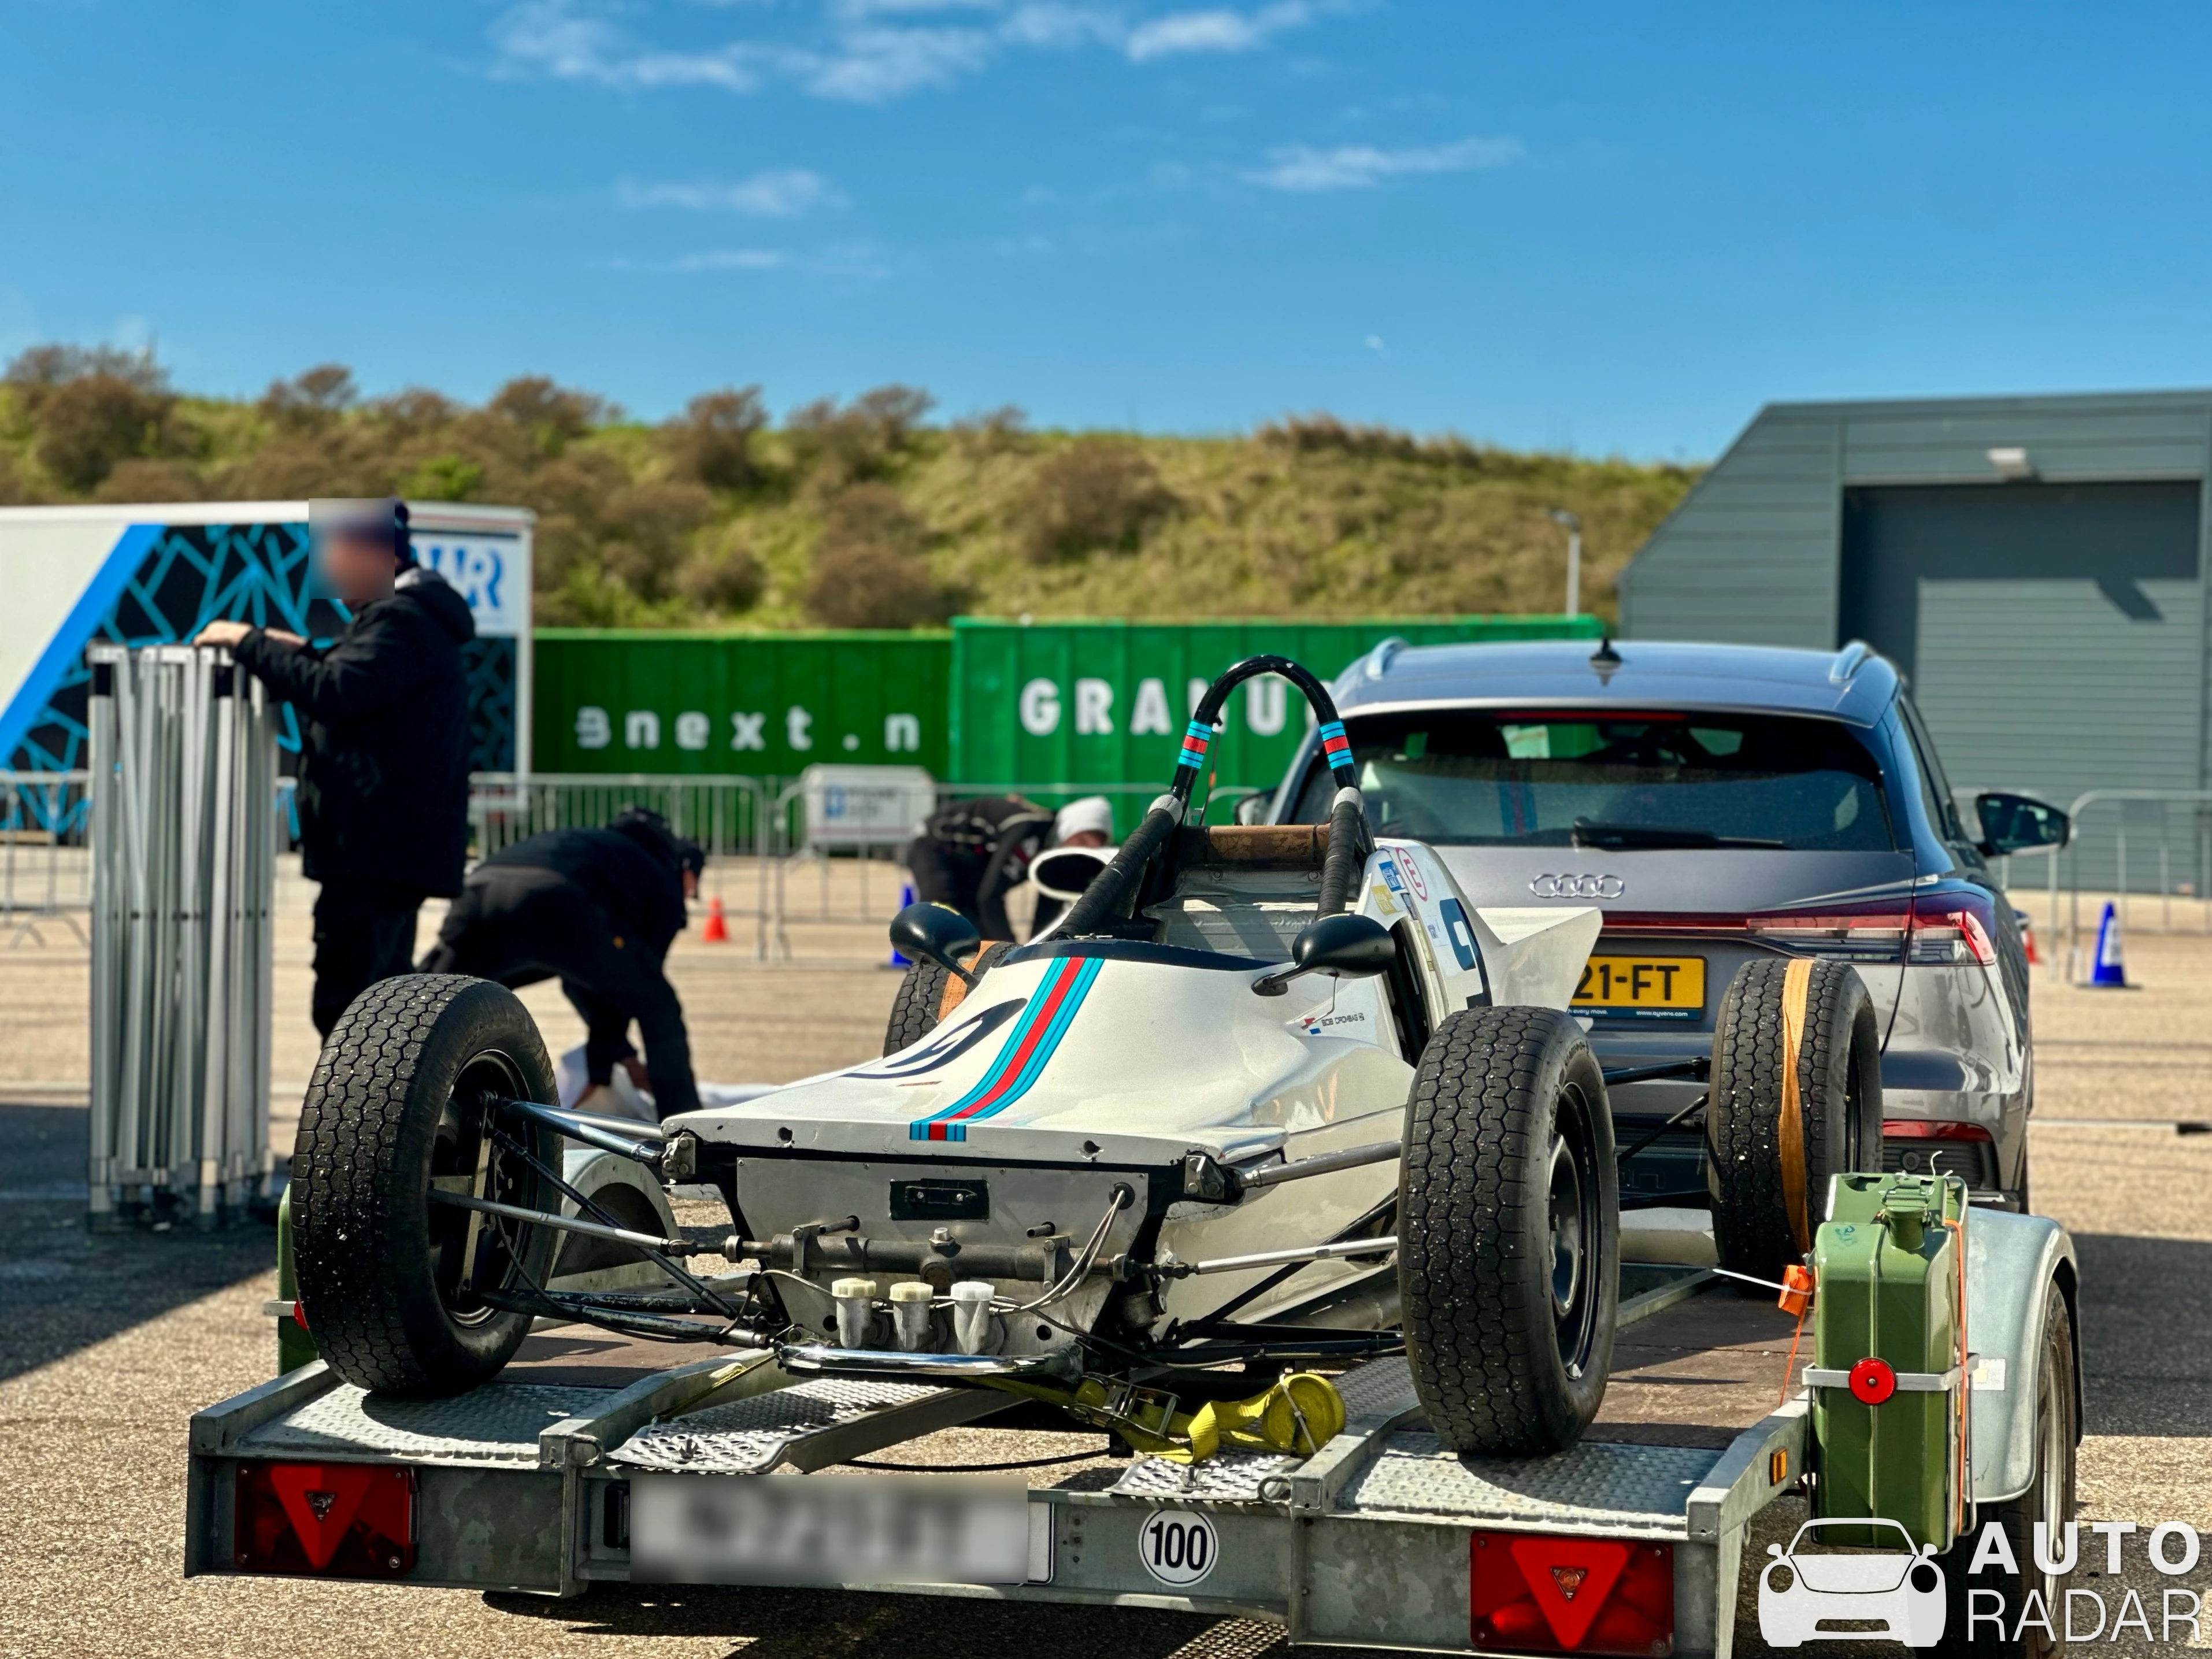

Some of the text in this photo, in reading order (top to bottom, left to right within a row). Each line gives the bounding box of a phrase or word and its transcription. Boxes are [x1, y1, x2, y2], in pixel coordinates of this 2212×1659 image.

[1019, 677, 1333, 736] GRAU
[1573, 964, 1680, 1001] 21-FT
[1150, 1521, 1207, 1571] 100
